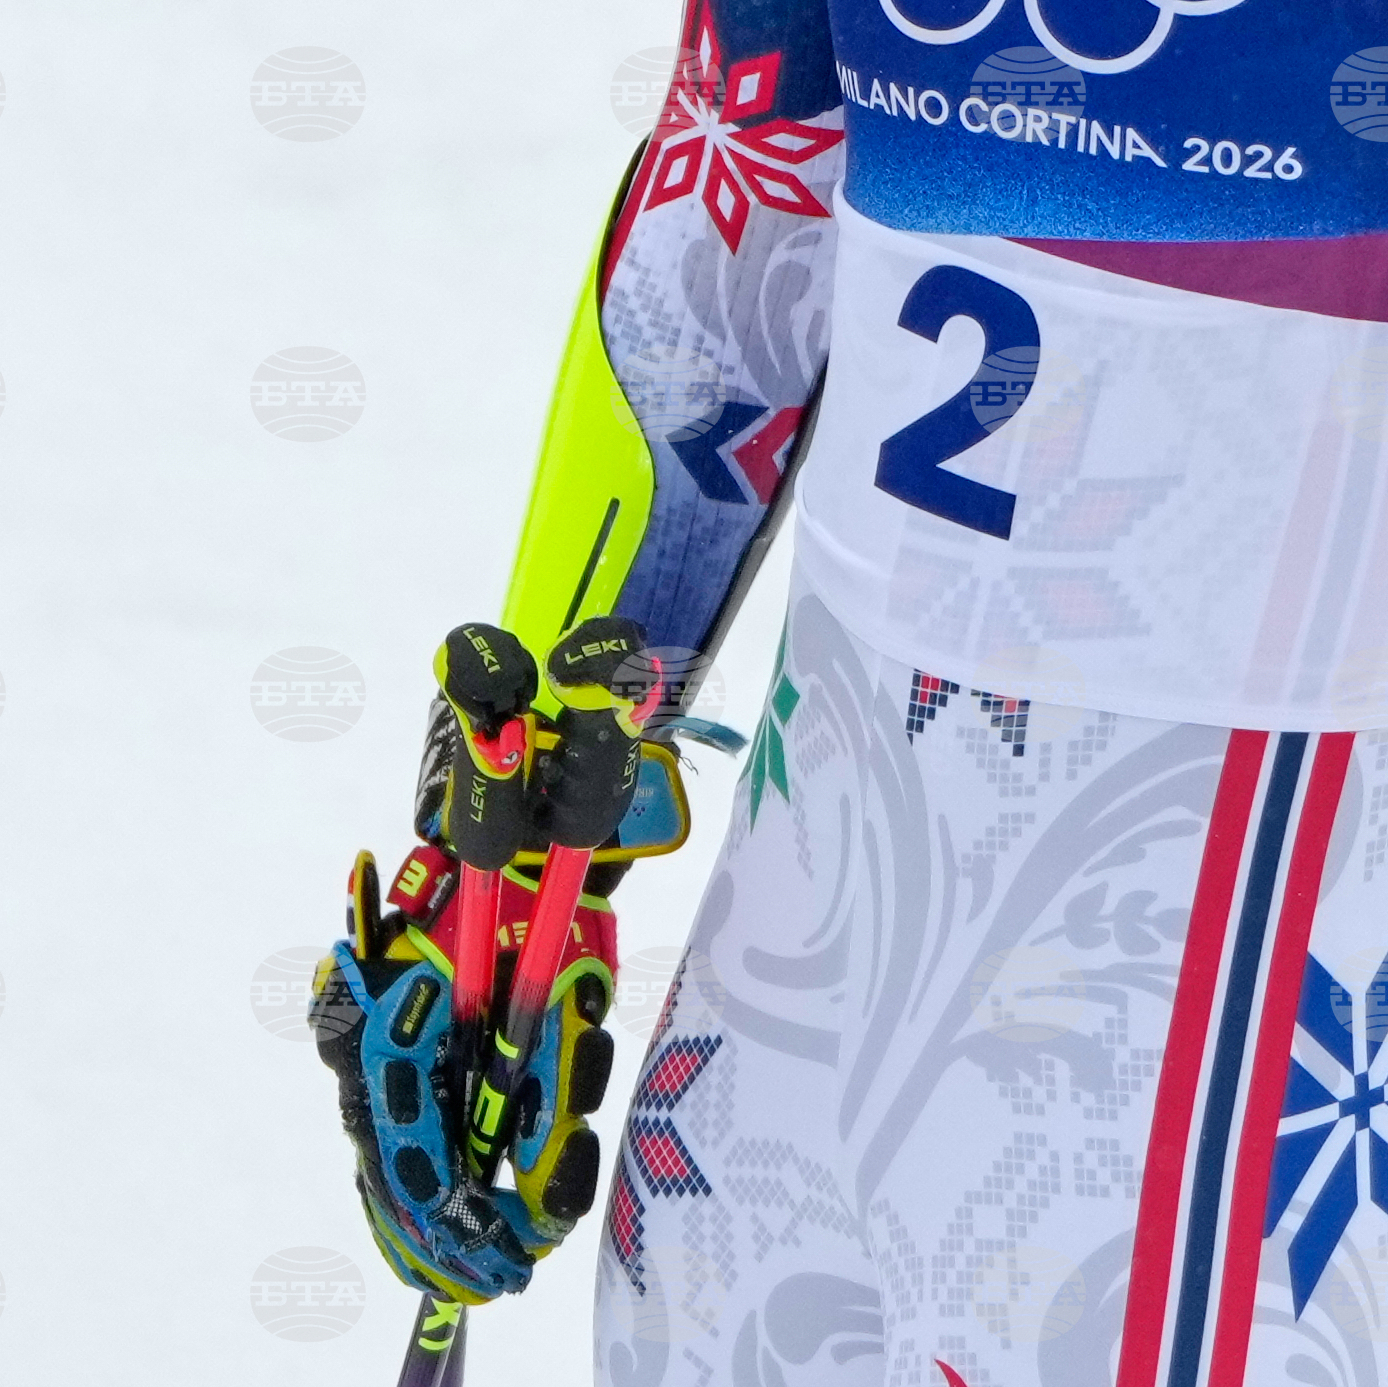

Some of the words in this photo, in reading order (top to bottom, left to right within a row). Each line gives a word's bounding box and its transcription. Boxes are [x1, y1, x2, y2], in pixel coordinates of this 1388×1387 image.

[836, 60, 949, 125] MILANO
[959, 97, 1168, 168] CORTINA
[1181, 137, 1303, 181] 2026
[874, 264, 1041, 541] 2
[463, 626, 501, 674] LEKI
[564, 638, 629, 665] LEKI
[470, 774, 488, 823] LEKI
